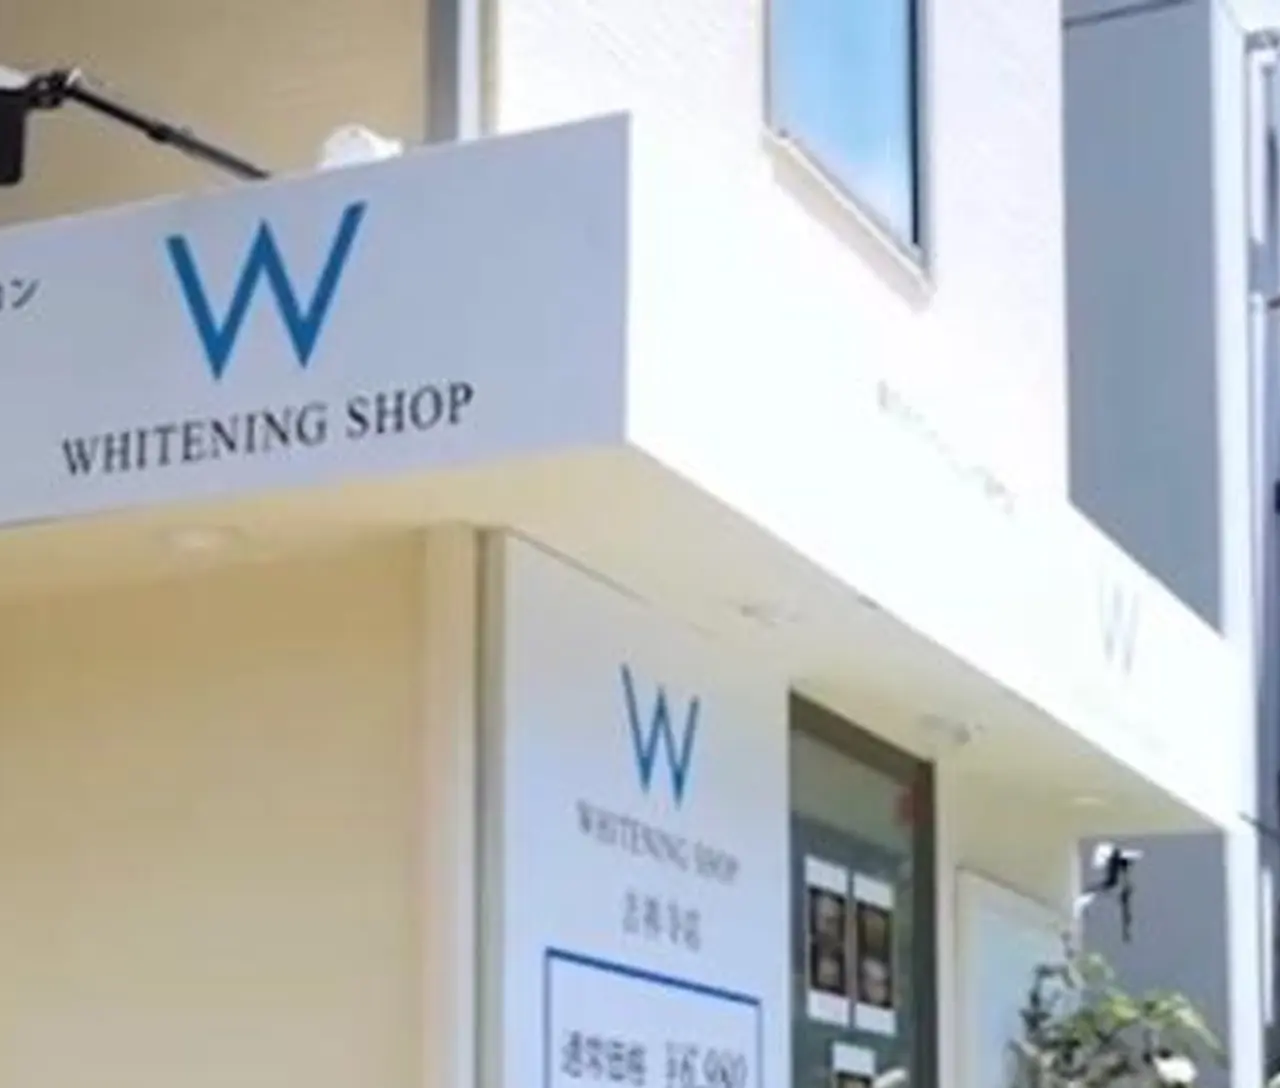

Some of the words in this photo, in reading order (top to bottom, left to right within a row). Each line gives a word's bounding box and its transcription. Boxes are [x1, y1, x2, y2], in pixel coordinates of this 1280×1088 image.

[167, 202, 368, 380] W
[61, 400, 328, 478] WHITENING
[345, 382, 478, 442] SHOP
[621, 661, 701, 810] W
